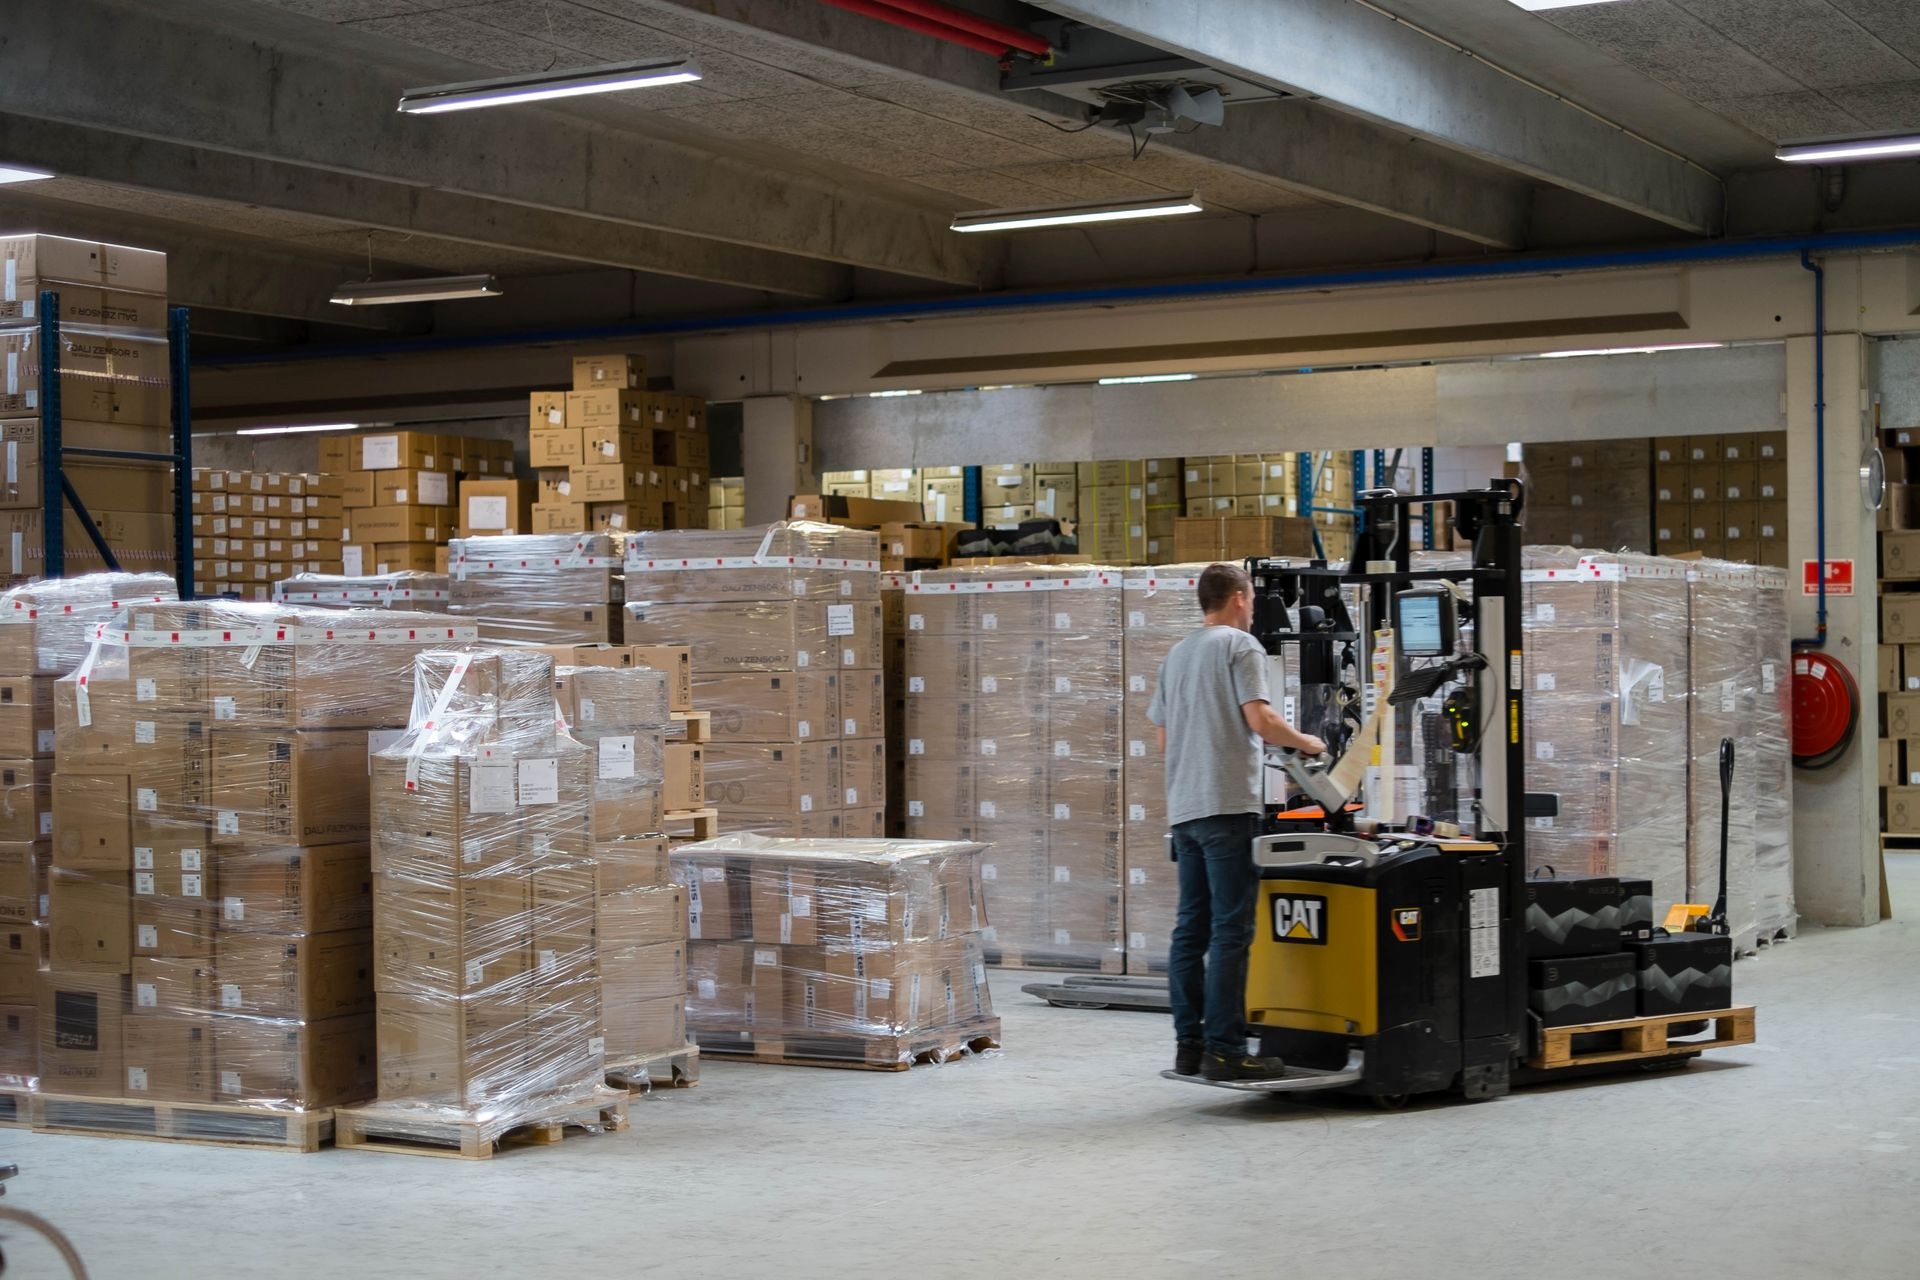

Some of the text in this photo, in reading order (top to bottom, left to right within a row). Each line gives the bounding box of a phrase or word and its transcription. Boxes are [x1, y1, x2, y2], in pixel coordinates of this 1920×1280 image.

[78, 307, 117, 320] ZENSOR
[117, 311, 138, 322] DALI
[71, 343, 91, 353] DALI
[92, 345, 131, 357] ZENSOR
[721, 584, 742, 593] DALI
[723, 656, 743, 664] DALI
[743, 655, 782, 664] ZENSOR
[303, 824, 324, 836] DALI
[17, 906, 26, 916] 6
[1275, 898, 1322, 939] CAT
[1400, 911, 1418, 925] CAT
